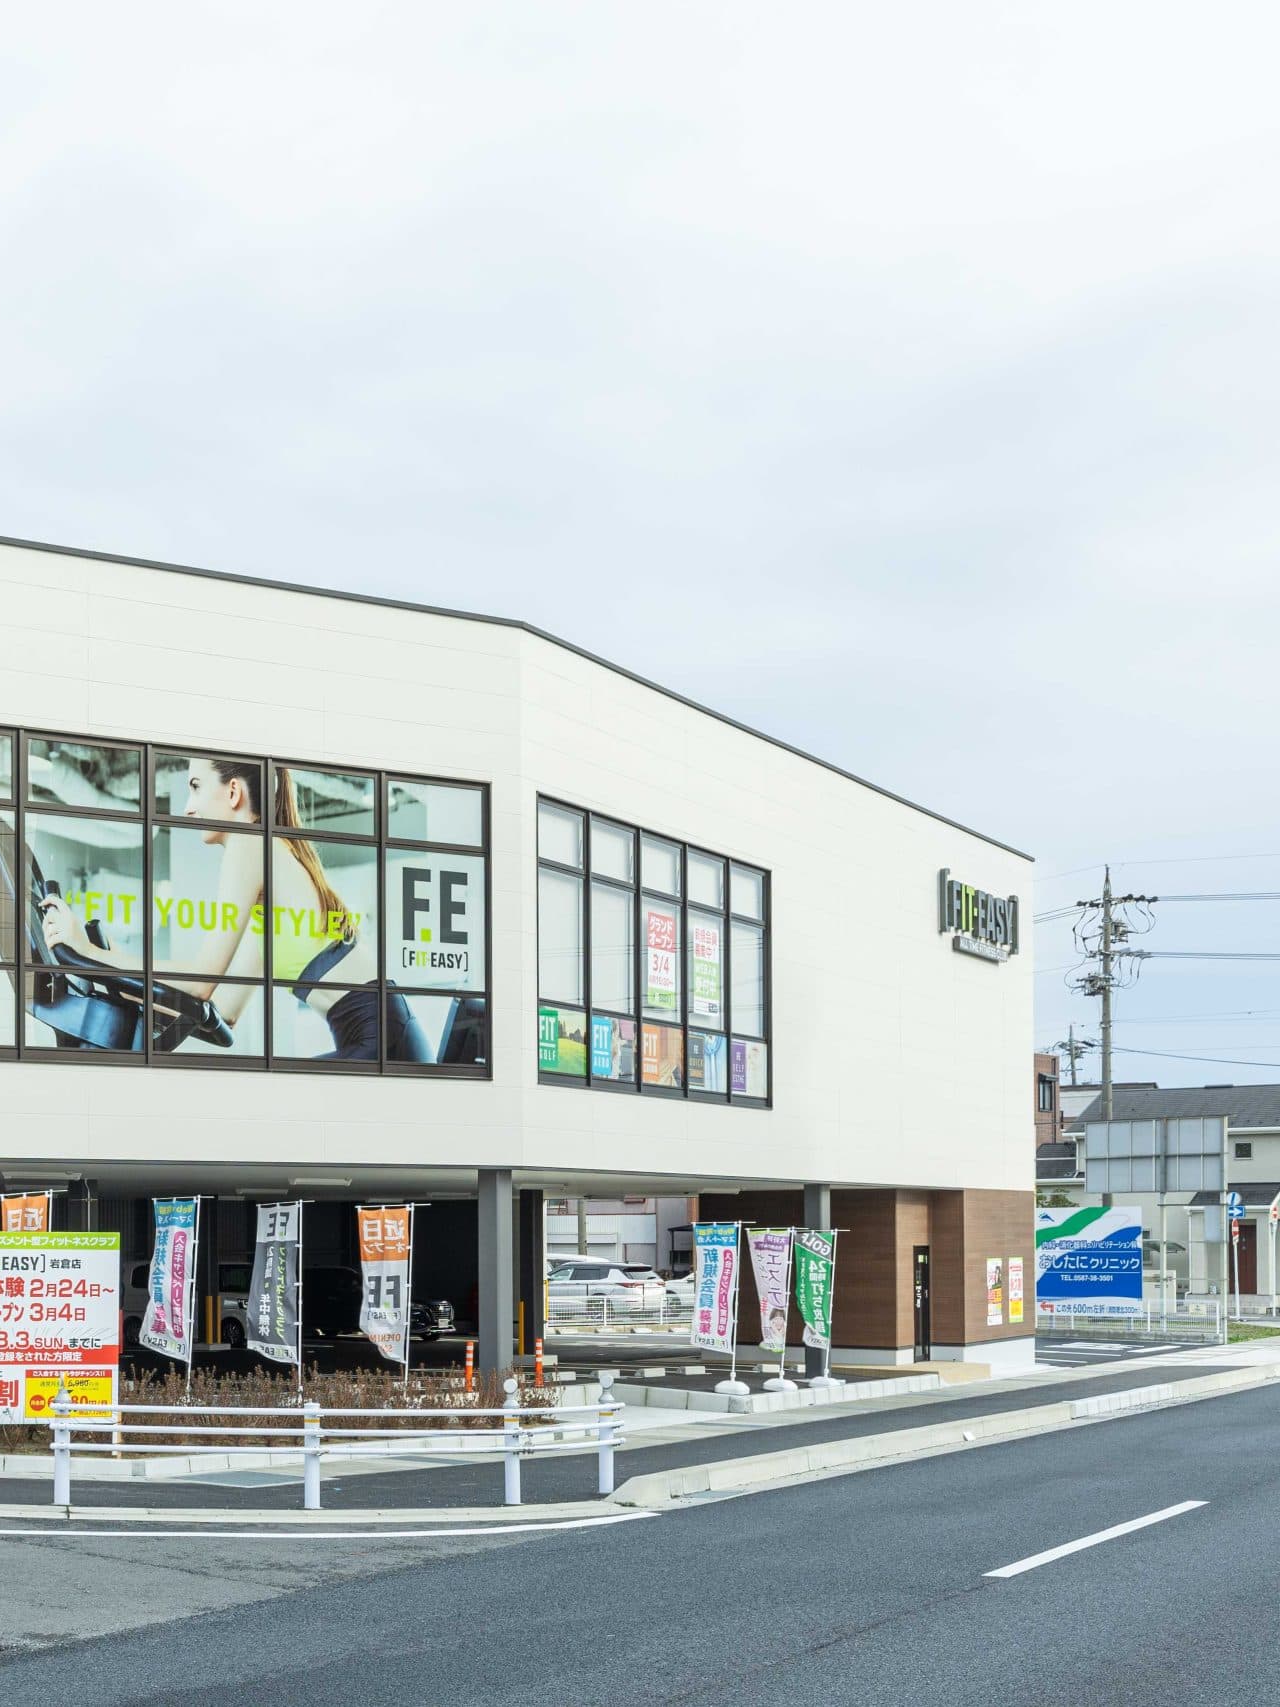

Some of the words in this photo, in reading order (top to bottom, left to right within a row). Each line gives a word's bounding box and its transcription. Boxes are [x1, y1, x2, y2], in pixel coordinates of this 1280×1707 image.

[153, 897, 238, 932] YOUR
[652, 954, 669, 974] 3/4
[539, 1015, 555, 1041] FIT
[593, 1024, 609, 1049] FIT
[643, 1032, 657, 1057] FIT
[50, 1258, 82, 1269] 岩倉店
[1039, 1254, 1140, 1269] おしたにクリニック
[29, 1302, 86, 1322] 3月4日
[34, 1337, 63, 1348] SUN
[69, 1338, 101, 1348] までに
